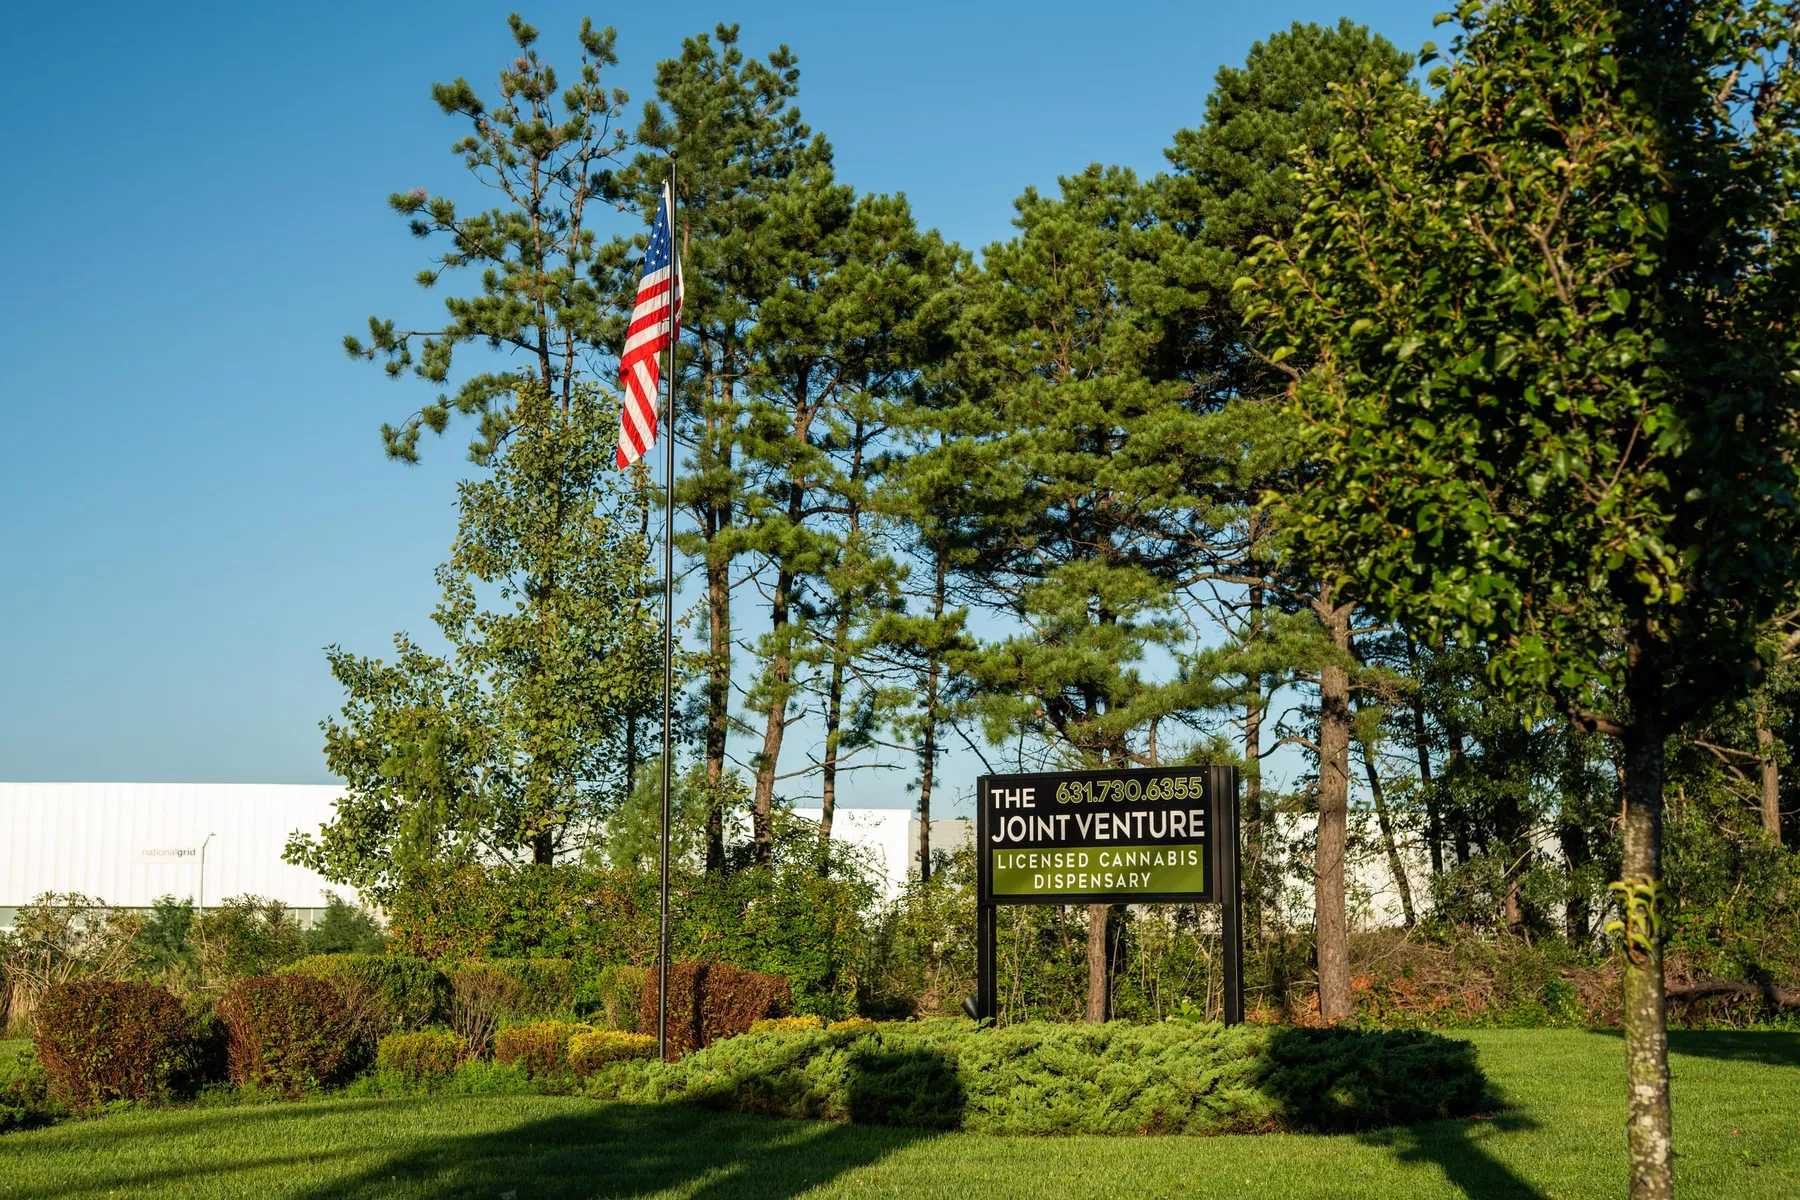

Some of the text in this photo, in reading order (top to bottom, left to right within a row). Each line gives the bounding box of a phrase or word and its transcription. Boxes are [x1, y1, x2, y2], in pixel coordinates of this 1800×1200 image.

[991, 788, 1036, 809] THE
[1056, 776, 1203, 804] 631.730.6355
[991, 809, 1205, 843] JOINT VENTURE
[998, 850, 1198, 869] LICENSED CANNABIS
[1034, 872, 1151, 889] DISPENSARY
